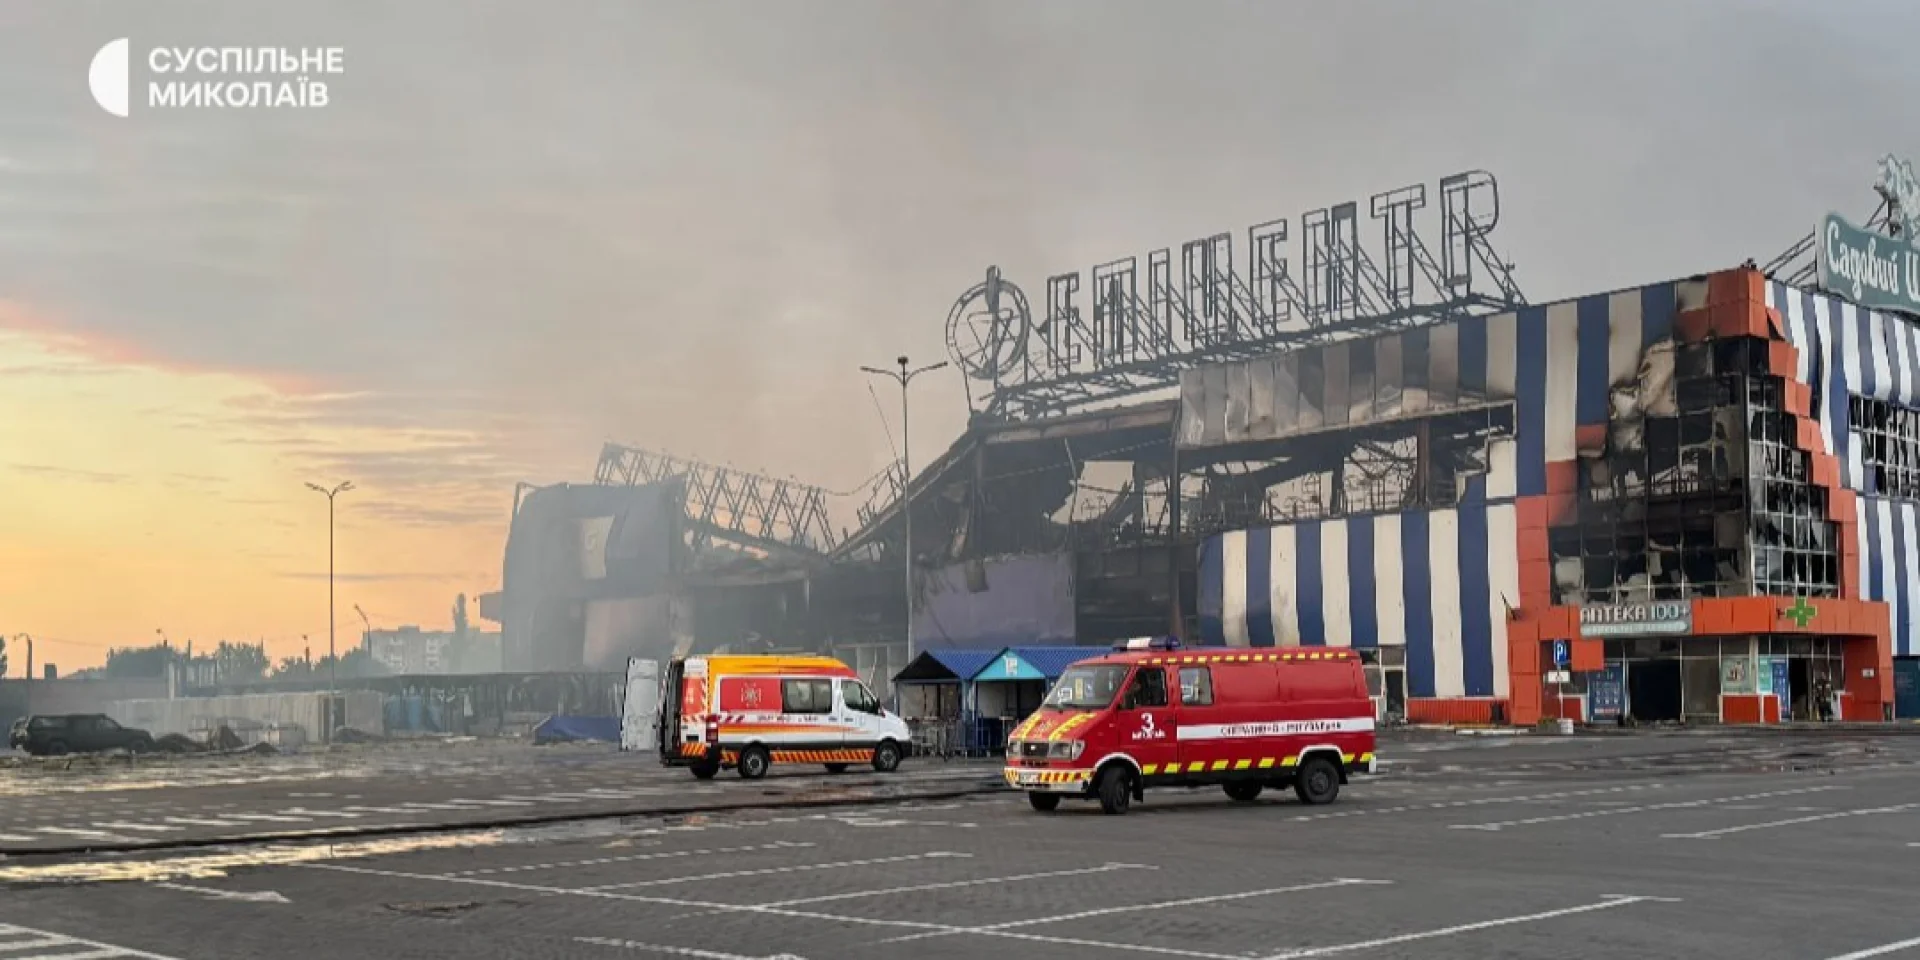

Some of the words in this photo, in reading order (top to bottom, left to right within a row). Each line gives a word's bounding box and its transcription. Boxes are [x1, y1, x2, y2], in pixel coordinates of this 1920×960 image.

[1827, 220, 1900, 300] Садовий
[1580, 605, 1647, 624] АПТЕКА
[1651, 603, 1690, 621] 100+
[1140, 712, 1155, 730] 3
